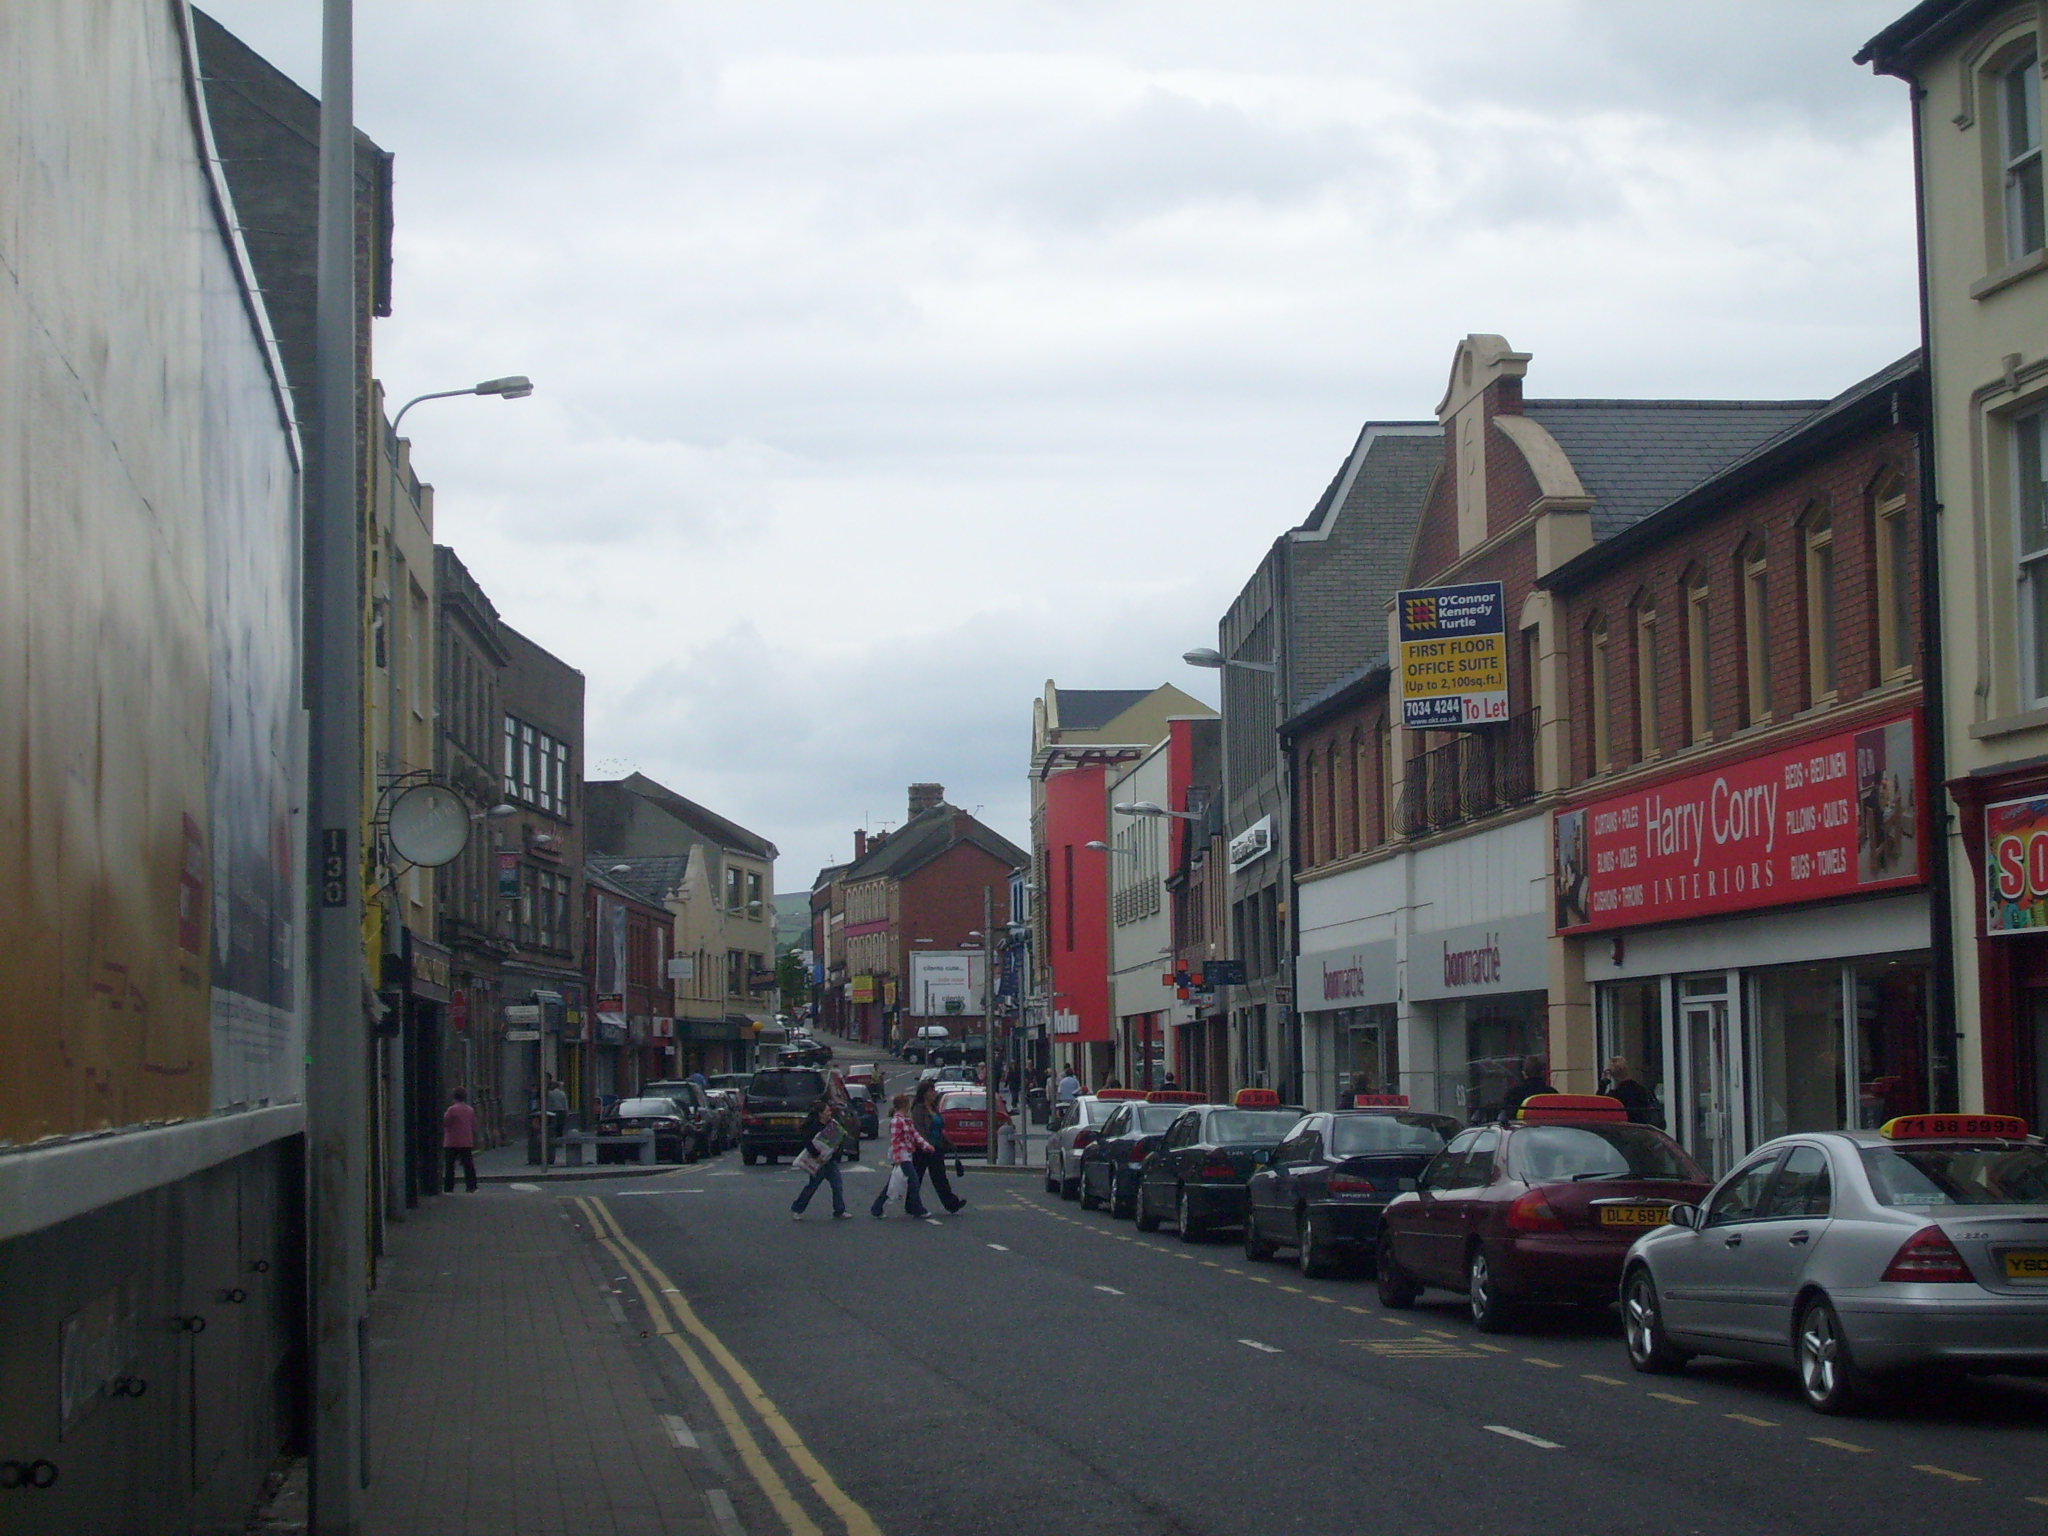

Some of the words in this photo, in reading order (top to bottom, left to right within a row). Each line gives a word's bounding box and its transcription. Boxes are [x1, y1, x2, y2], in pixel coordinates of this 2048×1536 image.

[1438, 593, 1496, 606] O'Connor
[1438, 604, 1493, 617] Kennedy
[1439, 617, 1477, 629] Turtle
[1409, 643, 1446, 658] FIRST
[1450, 639, 1495, 655] FLOOR
[1407, 661, 1455, 676] OFFICE
[1458, 656, 1498, 672] SUITE
[1405, 680, 1424, 693] (Up
[1427, 680, 1437, 690] to
[1406, 700, 1431, 717] 7034
[1434, 698, 1460, 714] 4244
[1463, 699, 1480, 720] To
[1484, 697, 1507, 719] Let
[1785, 762, 1803, 790] BEDS
[1622, 805, 1639, 829] POLES
[1645, 794, 1705, 868] Harry
[1711, 777, 1778, 853] Corry
[1785, 805, 1816, 835] PILLOWS
[1823, 798, 1849, 828] QUILTS
[1619, 845, 1637, 869] VOILES
[1790, 853, 1811, 880] RUGS
[1816, 846, 1848, 876] TOWELS
[1654, 859, 1774, 905] INTERIORS
[1621, 884, 1644, 908] THROWS
[1443, 932, 1501, 988] bonmarché
[1365, 1097, 1403, 1106] TAXI
[1901, 1120, 1925, 1132] 71
[1933, 1120, 1960, 1132] 88
[1966, 1120, 2019, 1133] 5995
[1607, 1209, 1634, 1223] DLZ
